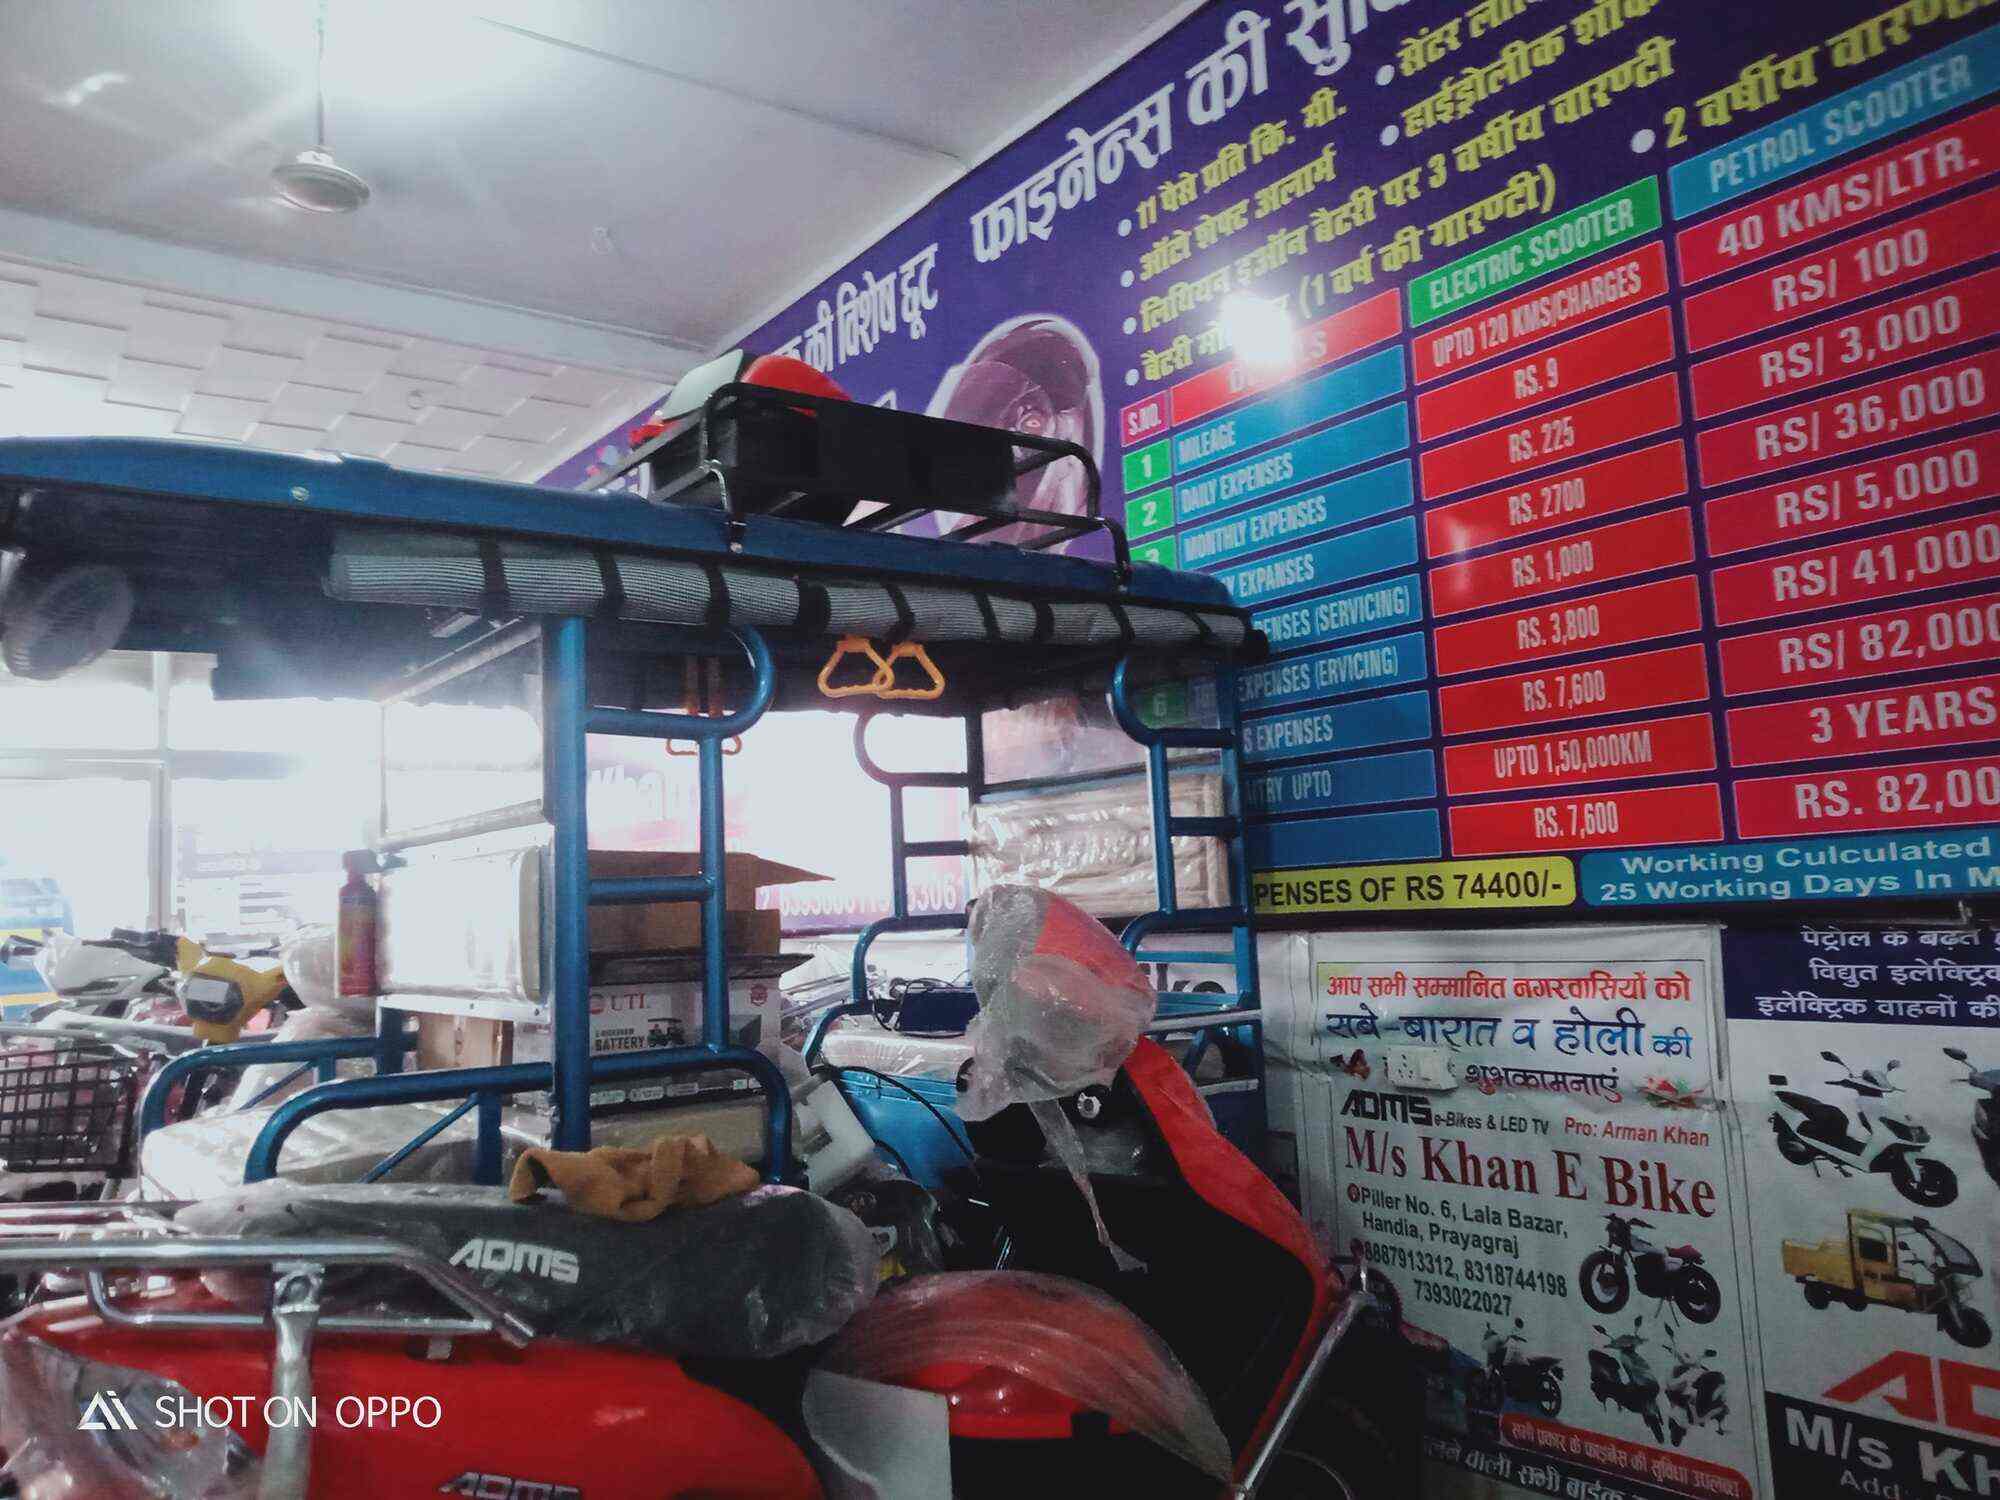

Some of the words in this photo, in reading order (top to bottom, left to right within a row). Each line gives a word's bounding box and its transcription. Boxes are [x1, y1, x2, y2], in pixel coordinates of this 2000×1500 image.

[1185, 10, 1271, 127] की
[1664, 106, 1688, 148] 2
[1710, 128, 1815, 193] PETROL
[1825, 54, 1972, 146] SCOOTER
[1380, 167, 1422, 206] पर
[1427, 153, 1447, 189] 3
[1136, 195, 1157, 229] 11
[1430, 245, 1525, 309] ELECTRIC
[1529, 199, 1634, 267] SCOOTER
[1718, 215, 1764, 256] 40
[1329, 244, 1375, 294] वर्ष
[1377, 226, 1424, 272] की
[1771, 258, 1838, 312] RS/
[1855, 228, 1928, 283] 100
[836, 271, 897, 365] विशेष
[899, 243, 938, 340] छूट
[1432, 327, 1474, 367] UPTO
[1479, 314, 1508, 349] 120
[1760, 335, 1824, 387] RS/
[1838, 296, 1960, 363] 3,000
[1514, 366, 1543, 399] RS.
[1547, 358, 1558, 387] 9
[1755, 411, 1819, 460] RS/
[1833, 367, 1985, 440] 36,000
[1509, 428, 1537, 463] RS.
[1541, 416, 1575, 453] 225
[1141, 454, 1151, 478] 1
[1775, 480, 1841, 528] RS/
[1855, 449, 1978, 510] 5,000
[1142, 501, 1157, 527] 2
[1509, 492, 1537, 525] RS.
[1541, 478, 1586, 517] 2700
[1511, 554, 1541, 587] RS.
[1545, 541, 1594, 582] 1,000
[1772, 556, 1837, 601] RS/
[1852, 523, 2000, 585] 41,000
[1517, 619, 1546, 649] RS.
[1550, 605, 1599, 647] 3,800
[1779, 630, 1845, 674] RS/
[1523, 680, 1552, 711] RS.
[1556, 669, 1606, 710] 7,600
[1256, 714, 1333, 750] EXPENSES
[1809, 707, 1833, 744] 3
[1846, 686, 1999, 739] YEARS
[1494, 746, 1538, 779] UPTO
[1544, 730, 1652, 777] 1,50,000KM
[1292, 770, 1332, 800] UPTO
[1795, 779, 1863, 819] RS.
[1877, 766, 2000, 814] 82,00
[1534, 807, 1563, 838] RS.
[1567, 801, 1619, 839] 7,600
[1621, 850, 1764, 876] Working
[1776, 837, 1990, 868] Culculated
[1254, 877, 1352, 906] PENSES
[1361, 876, 1396, 900] OF
[1406, 873, 1444, 900] RS
[1453, 869, 1562, 900] 74400/-
[1599, 883, 1637, 901] 25
[1644, 876, 1791, 900] Working
[1805, 874, 1900, 897] Days
[1915, 869, 1951, 889] In
[1801, 925, 1870, 951] पेट्रोल
[1327, 976, 1362, 997] आप
[1367, 971, 1408, 998] सभी
[1412, 970, 1507, 999] सम्मानित
[1654, 970, 1692, 1001] को
[1809, 957, 1879, 988] विद्युत
[1876, 993, 1957, 1018] वाहनों
[1512, 1019, 1541, 1050] व
[1553, 1006, 1646, 1056] होली
[1652, 1026, 1693, 1059] की
[1487, 1114, 1496, 1130] &
[1500, 1116, 1529, 1133] LED
[1532, 1119, 1549, 1136] TV
[1564, 1117, 1597, 1137] Pro:
[1602, 1121, 1657, 1142] Arman
[1664, 1127, 1710, 1147] Khan
[1344, 1126, 1407, 1177] M/s
[1418, 1136, 1539, 1195] Khan
[1552, 1149, 1588, 1200] E
[1599, 1156, 1716, 1218] Bike
[1361, 1187, 1400, 1210] Piller
[1406, 1194, 1435, 1216] No.
[1441, 1200, 1456, 1222] 6,
[1463, 1202, 1502, 1225] Lala
[1508, 1209, 1569, 1238] Bazar,
[1363, 1212, 1424, 1242] Handia,
[1429, 1223, 1519, 1258] Prayagraj
[449, 1238, 580, 1284] ADMS
